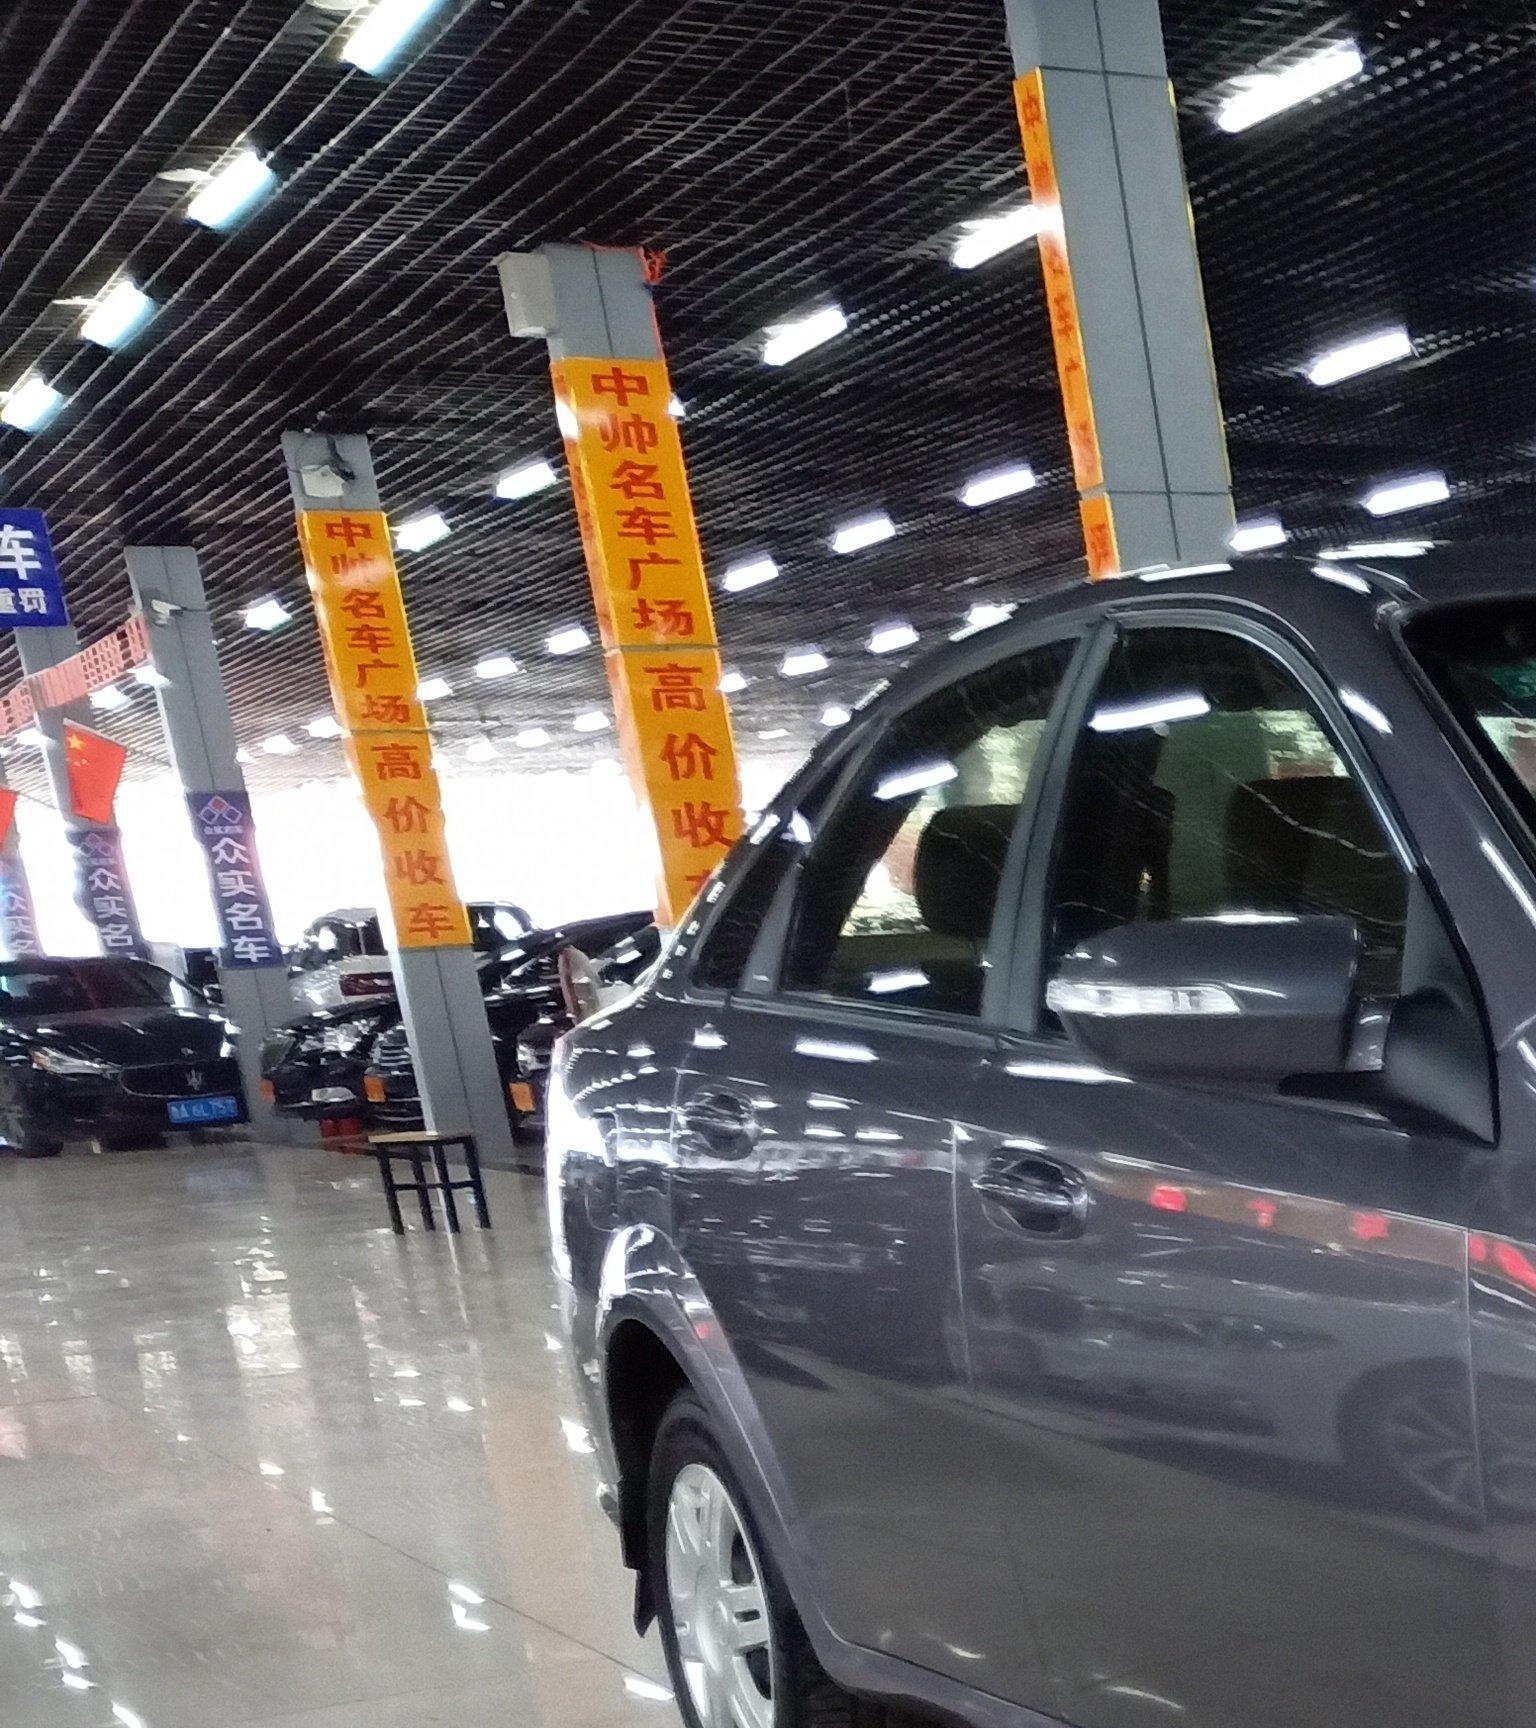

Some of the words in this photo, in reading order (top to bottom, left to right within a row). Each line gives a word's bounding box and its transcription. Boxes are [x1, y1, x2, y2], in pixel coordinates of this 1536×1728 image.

[591, 367, 695, 637] 中帅名车广场
[371, 743, 455, 939] 高价收车
